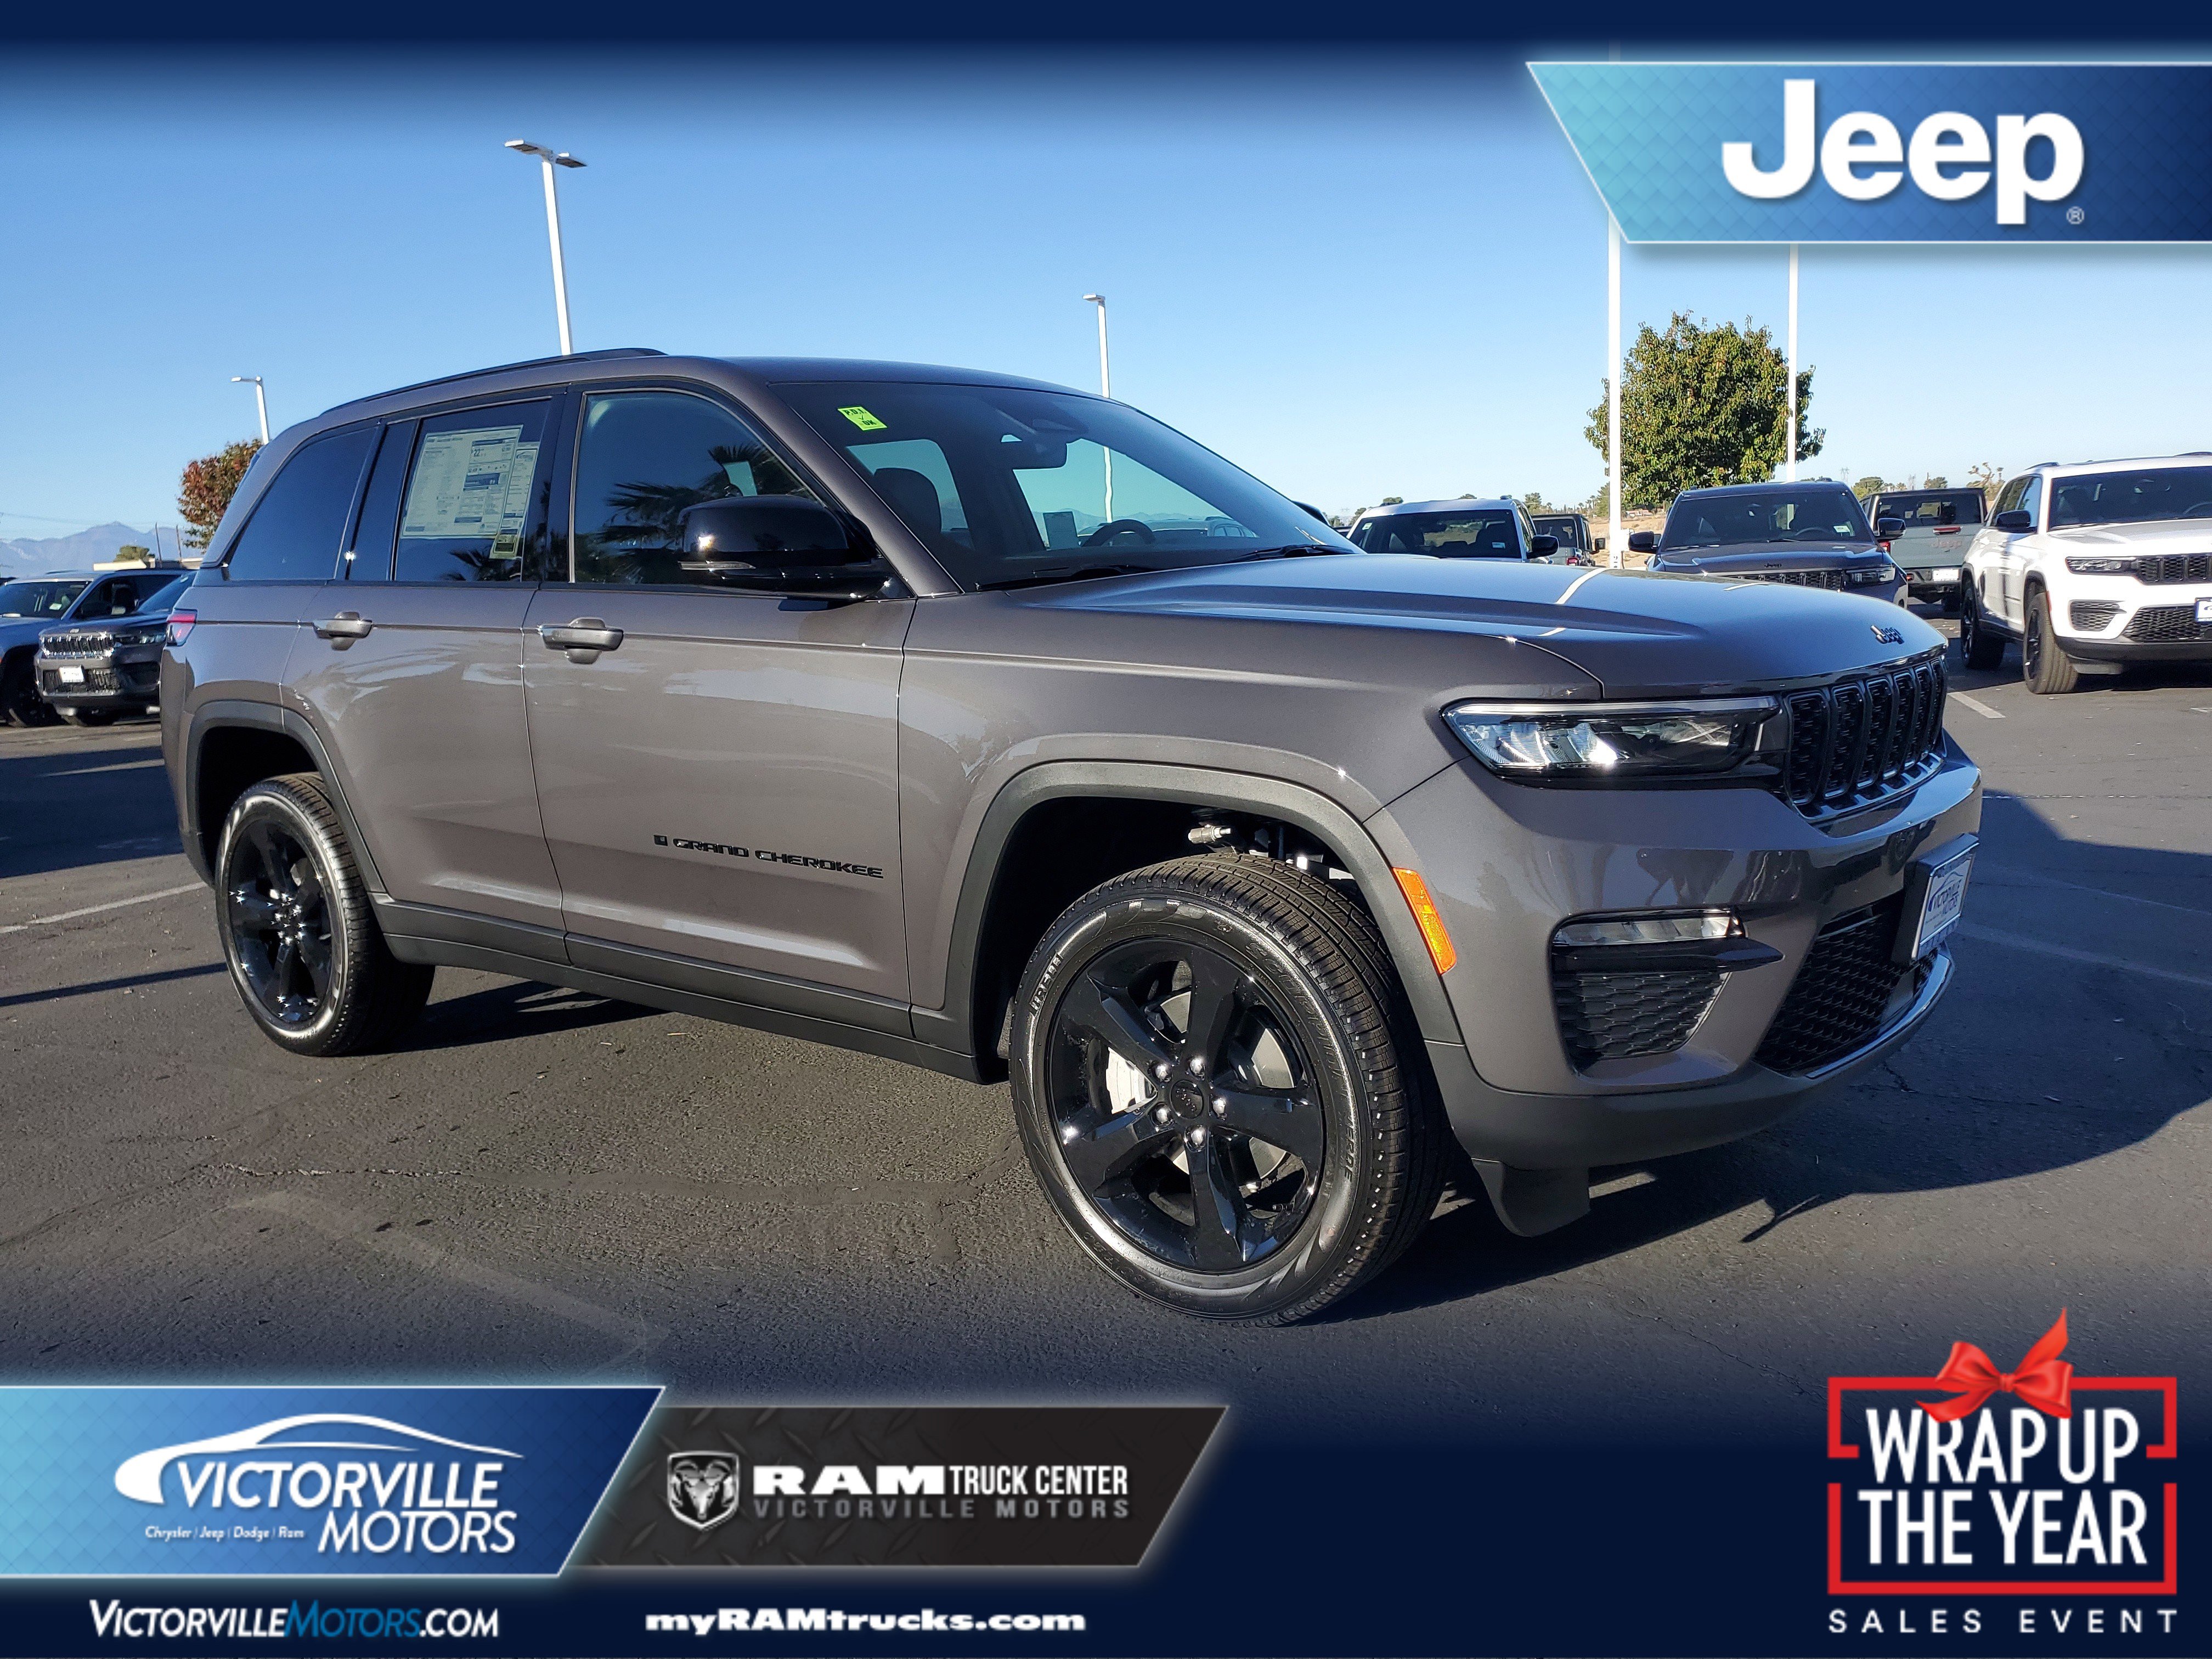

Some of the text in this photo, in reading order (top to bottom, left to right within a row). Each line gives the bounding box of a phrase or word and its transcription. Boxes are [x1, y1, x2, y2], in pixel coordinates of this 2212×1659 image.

[1870, 624, 1904, 645] Jeep
[673, 838, 884, 878] GRAND CHEROKEE
